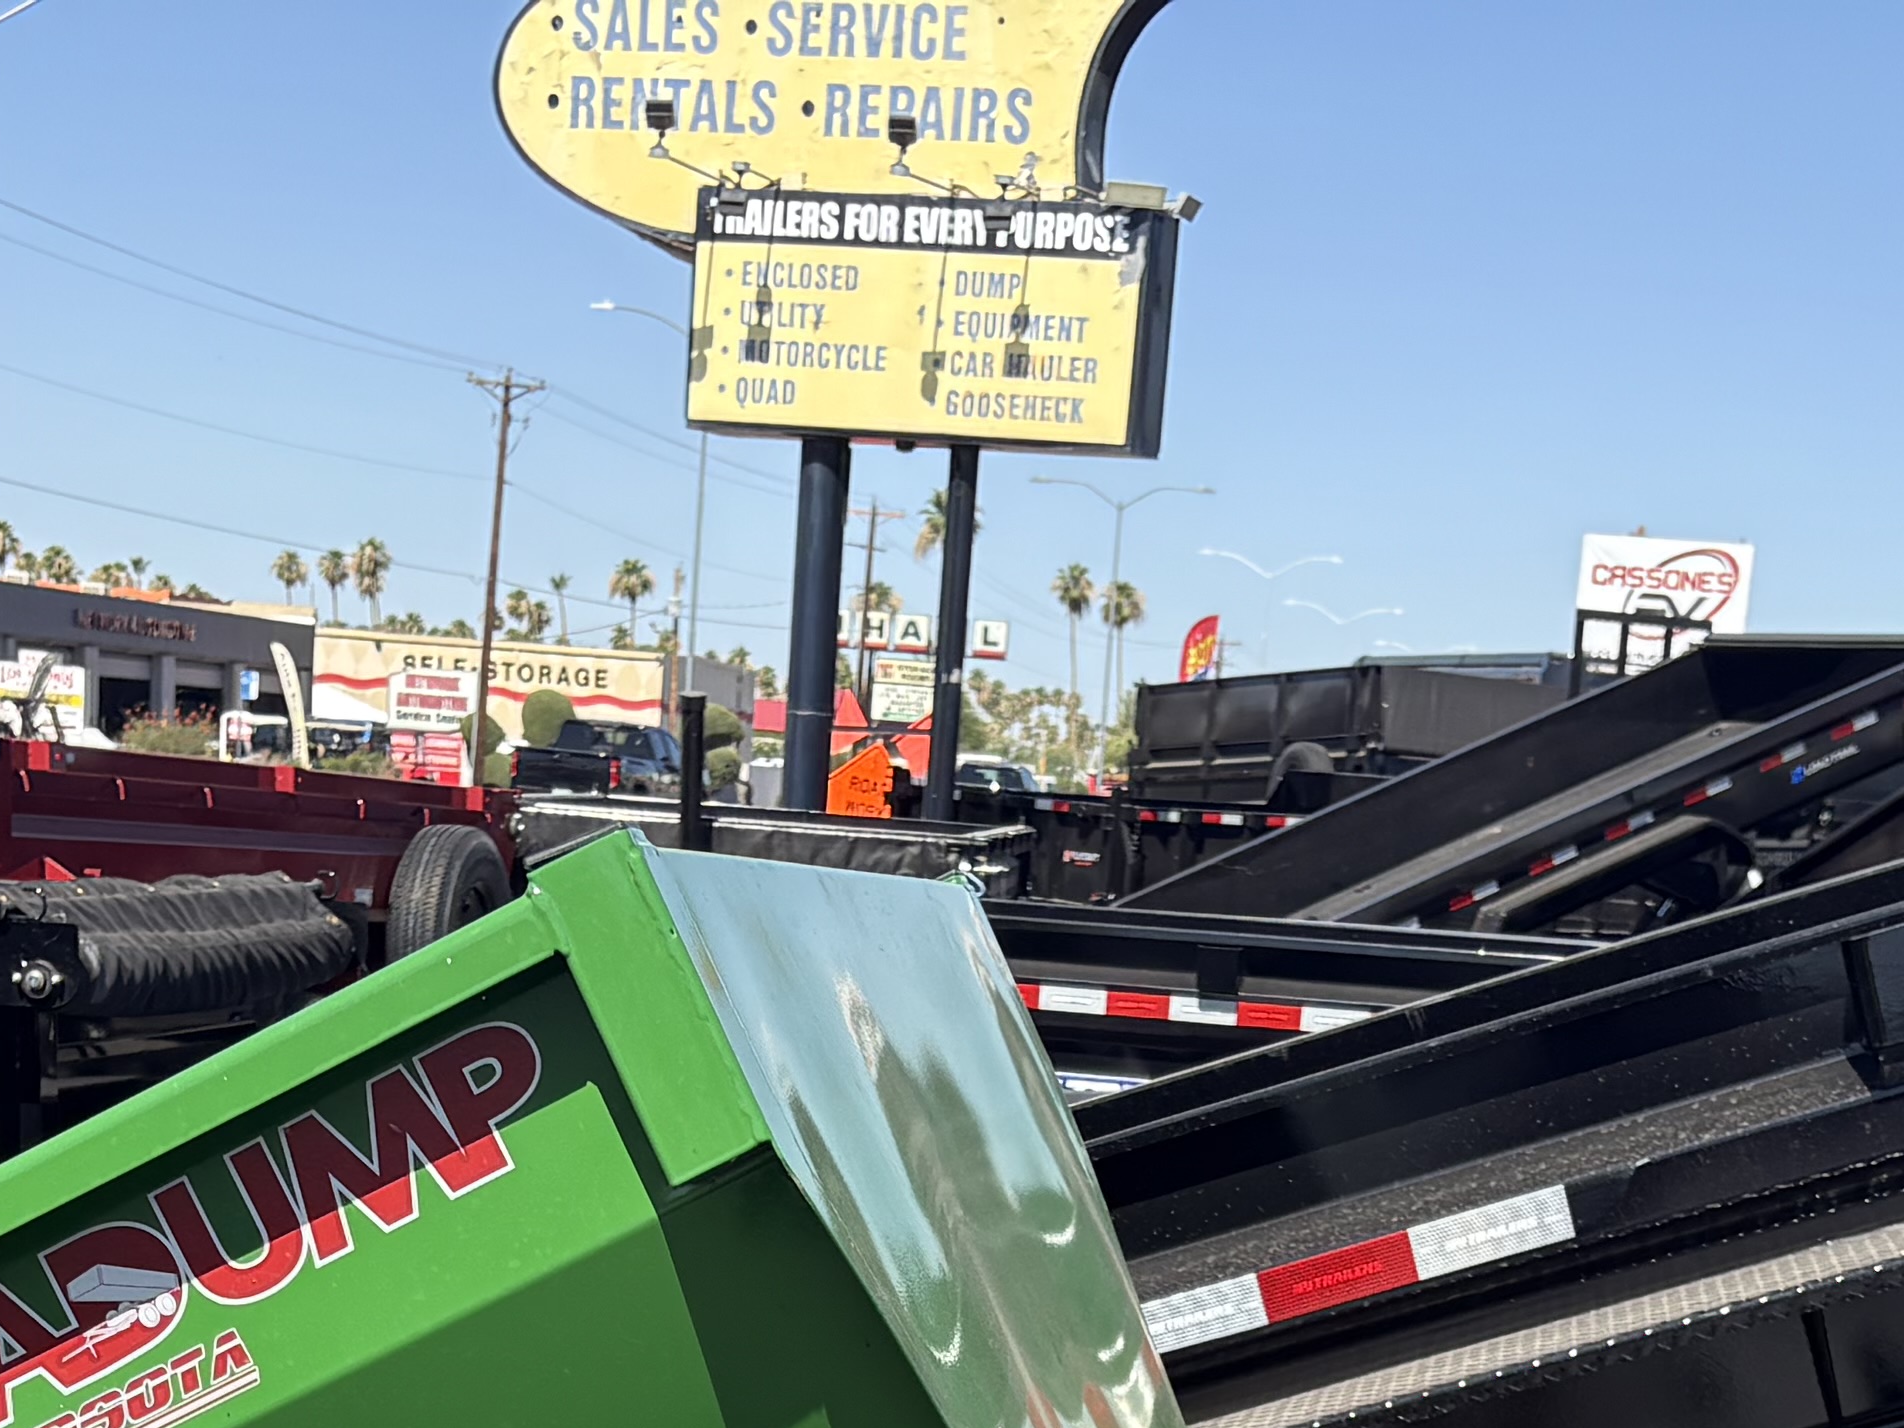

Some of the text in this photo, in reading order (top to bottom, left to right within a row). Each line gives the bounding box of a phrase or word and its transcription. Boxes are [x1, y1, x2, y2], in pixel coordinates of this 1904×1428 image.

[572, 0, 967, 61] SALES SERVICE
[569, 76, 1032, 145] RENTALS REPAIRS
[844, 204, 899, 243] FOR
[741, 261, 859, 291] ENCLOSED
[954, 270, 1021, 299] DUMP
[953, 311, 1090, 344] EQUIPMENT
[738, 339, 888, 371] MOTORCYCLE
[950, 351, 994, 378] CAR
[735, 376, 796, 408] QUAD
[1591, 564, 1735, 594] CASSONES
